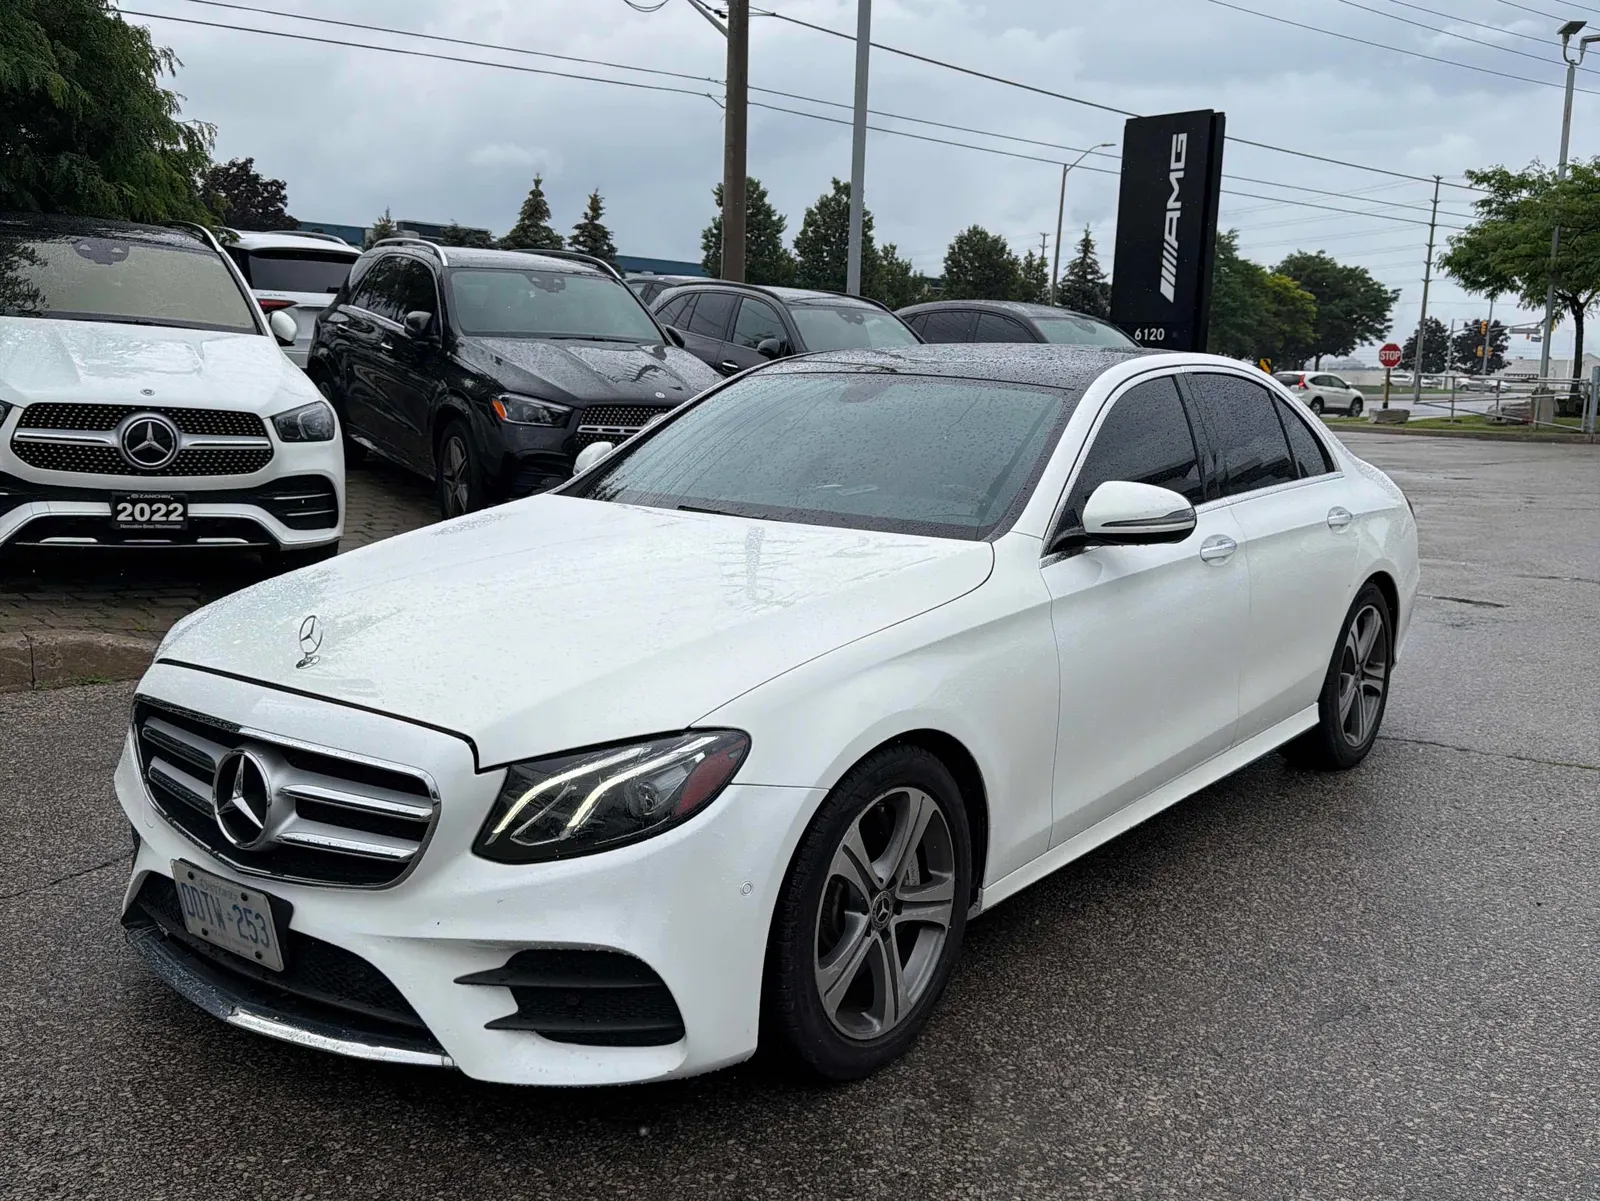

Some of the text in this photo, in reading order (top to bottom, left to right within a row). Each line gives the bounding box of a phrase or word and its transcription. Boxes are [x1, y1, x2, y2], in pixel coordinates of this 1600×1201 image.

[1162, 132, 1188, 251] AMG
[1134, 327, 1165, 341] 6120
[1380, 350, 1401, 360] STOP
[116, 502, 184, 521] 2022
[232, 904, 270, 949] 253
